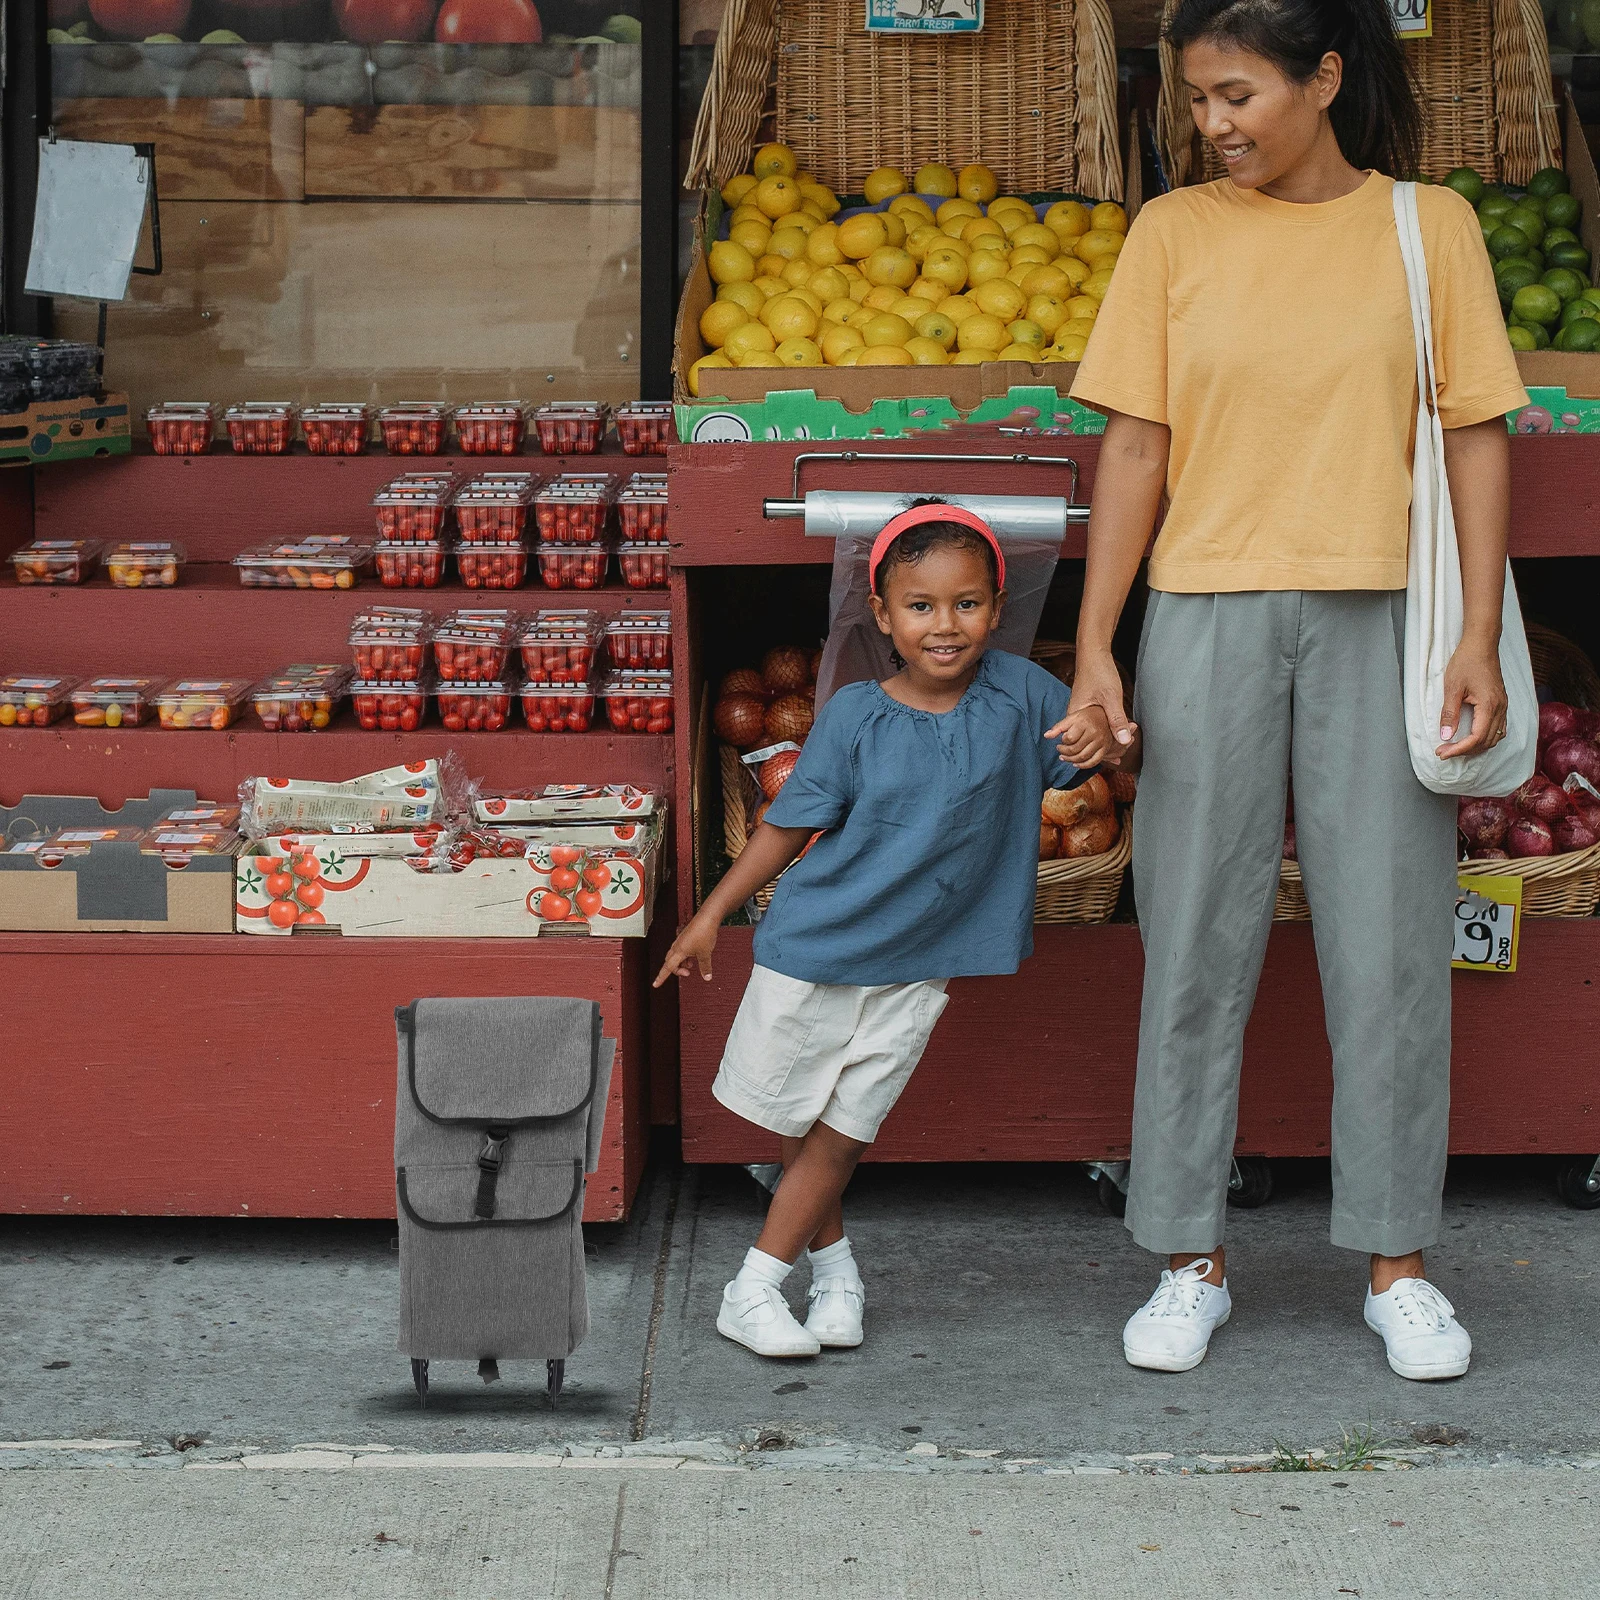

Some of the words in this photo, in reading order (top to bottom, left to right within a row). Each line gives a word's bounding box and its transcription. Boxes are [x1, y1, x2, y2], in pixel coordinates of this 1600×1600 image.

[893, 18, 920, 28] FARM
[923, 19, 955, 30] FRESH
[1452, 922, 1494, 964] 9
[1495, 937, 1511, 971] BAG
